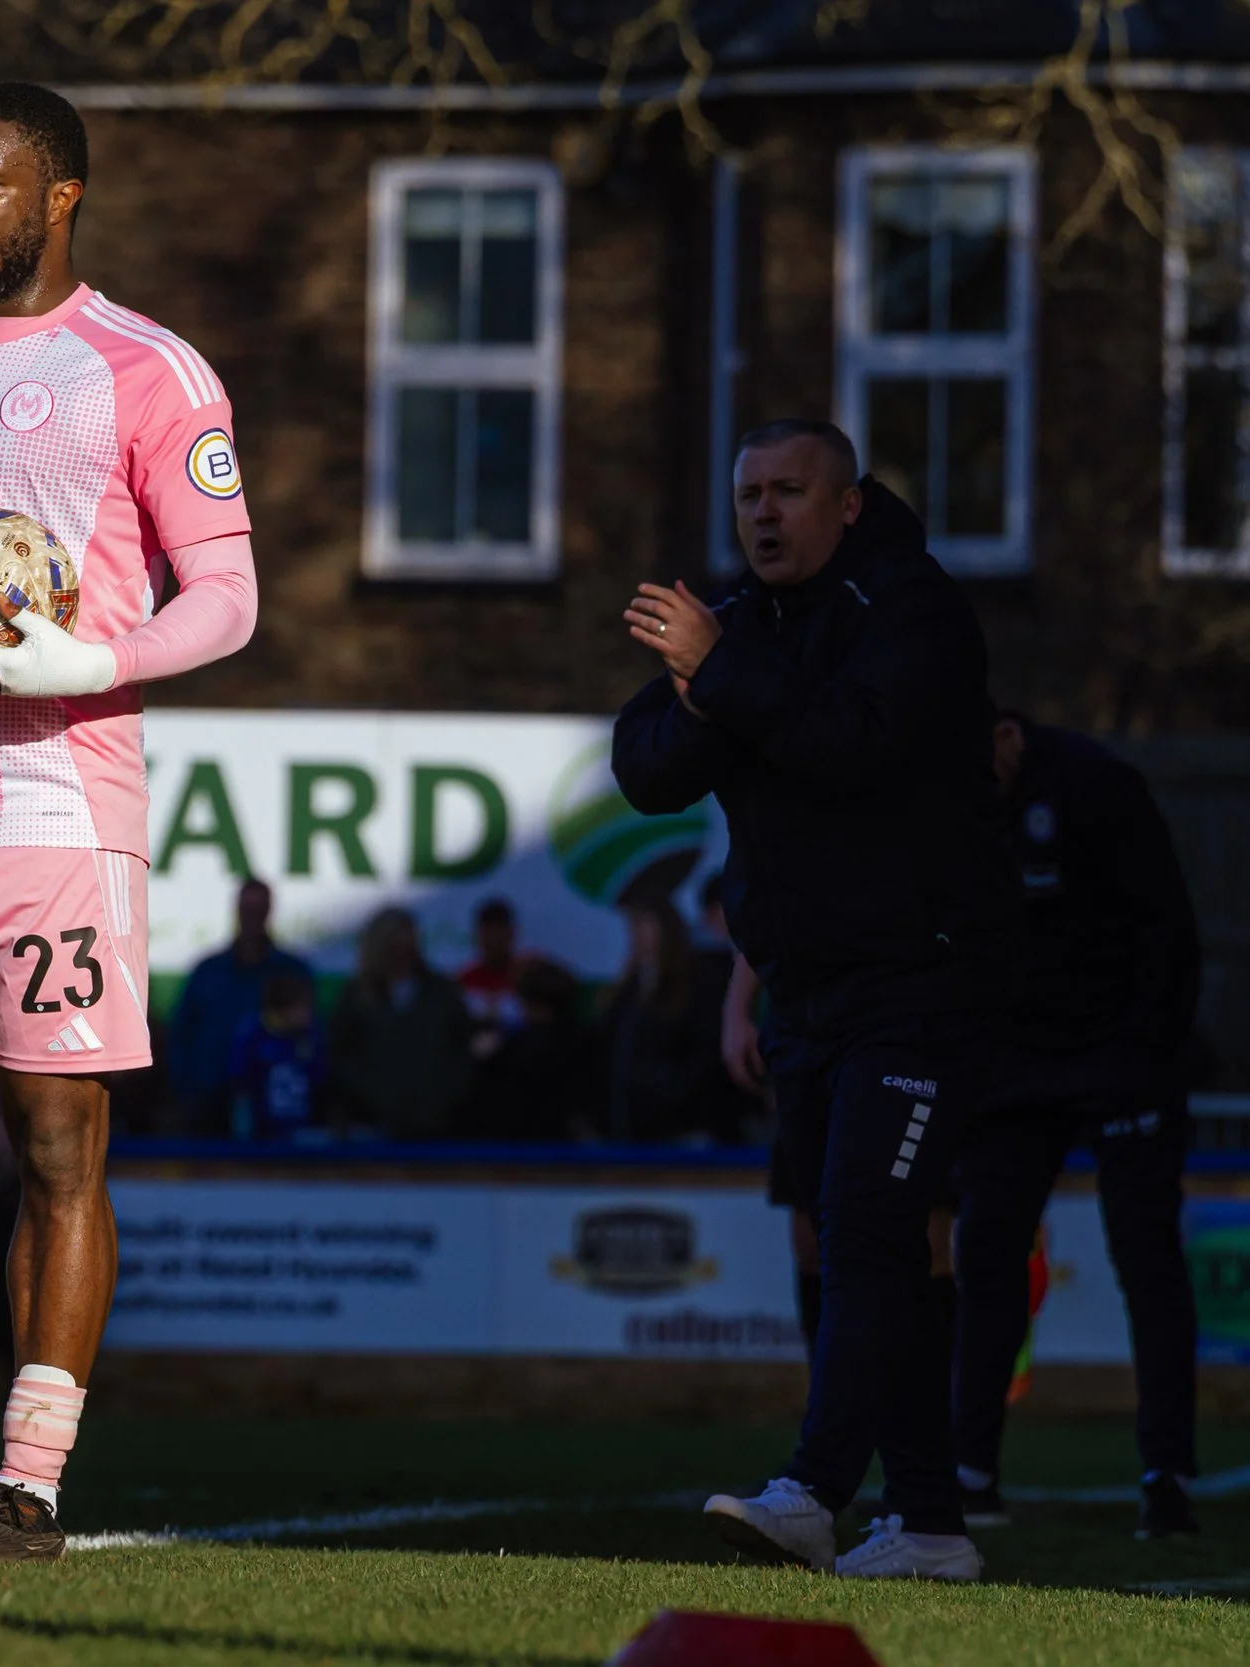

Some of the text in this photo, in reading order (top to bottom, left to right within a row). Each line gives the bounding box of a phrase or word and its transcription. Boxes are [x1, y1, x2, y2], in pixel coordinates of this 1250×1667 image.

[208, 452, 232, 479] B
[13, 926, 104, 1014] 23
[882, 1075, 937, 1095] capelli
